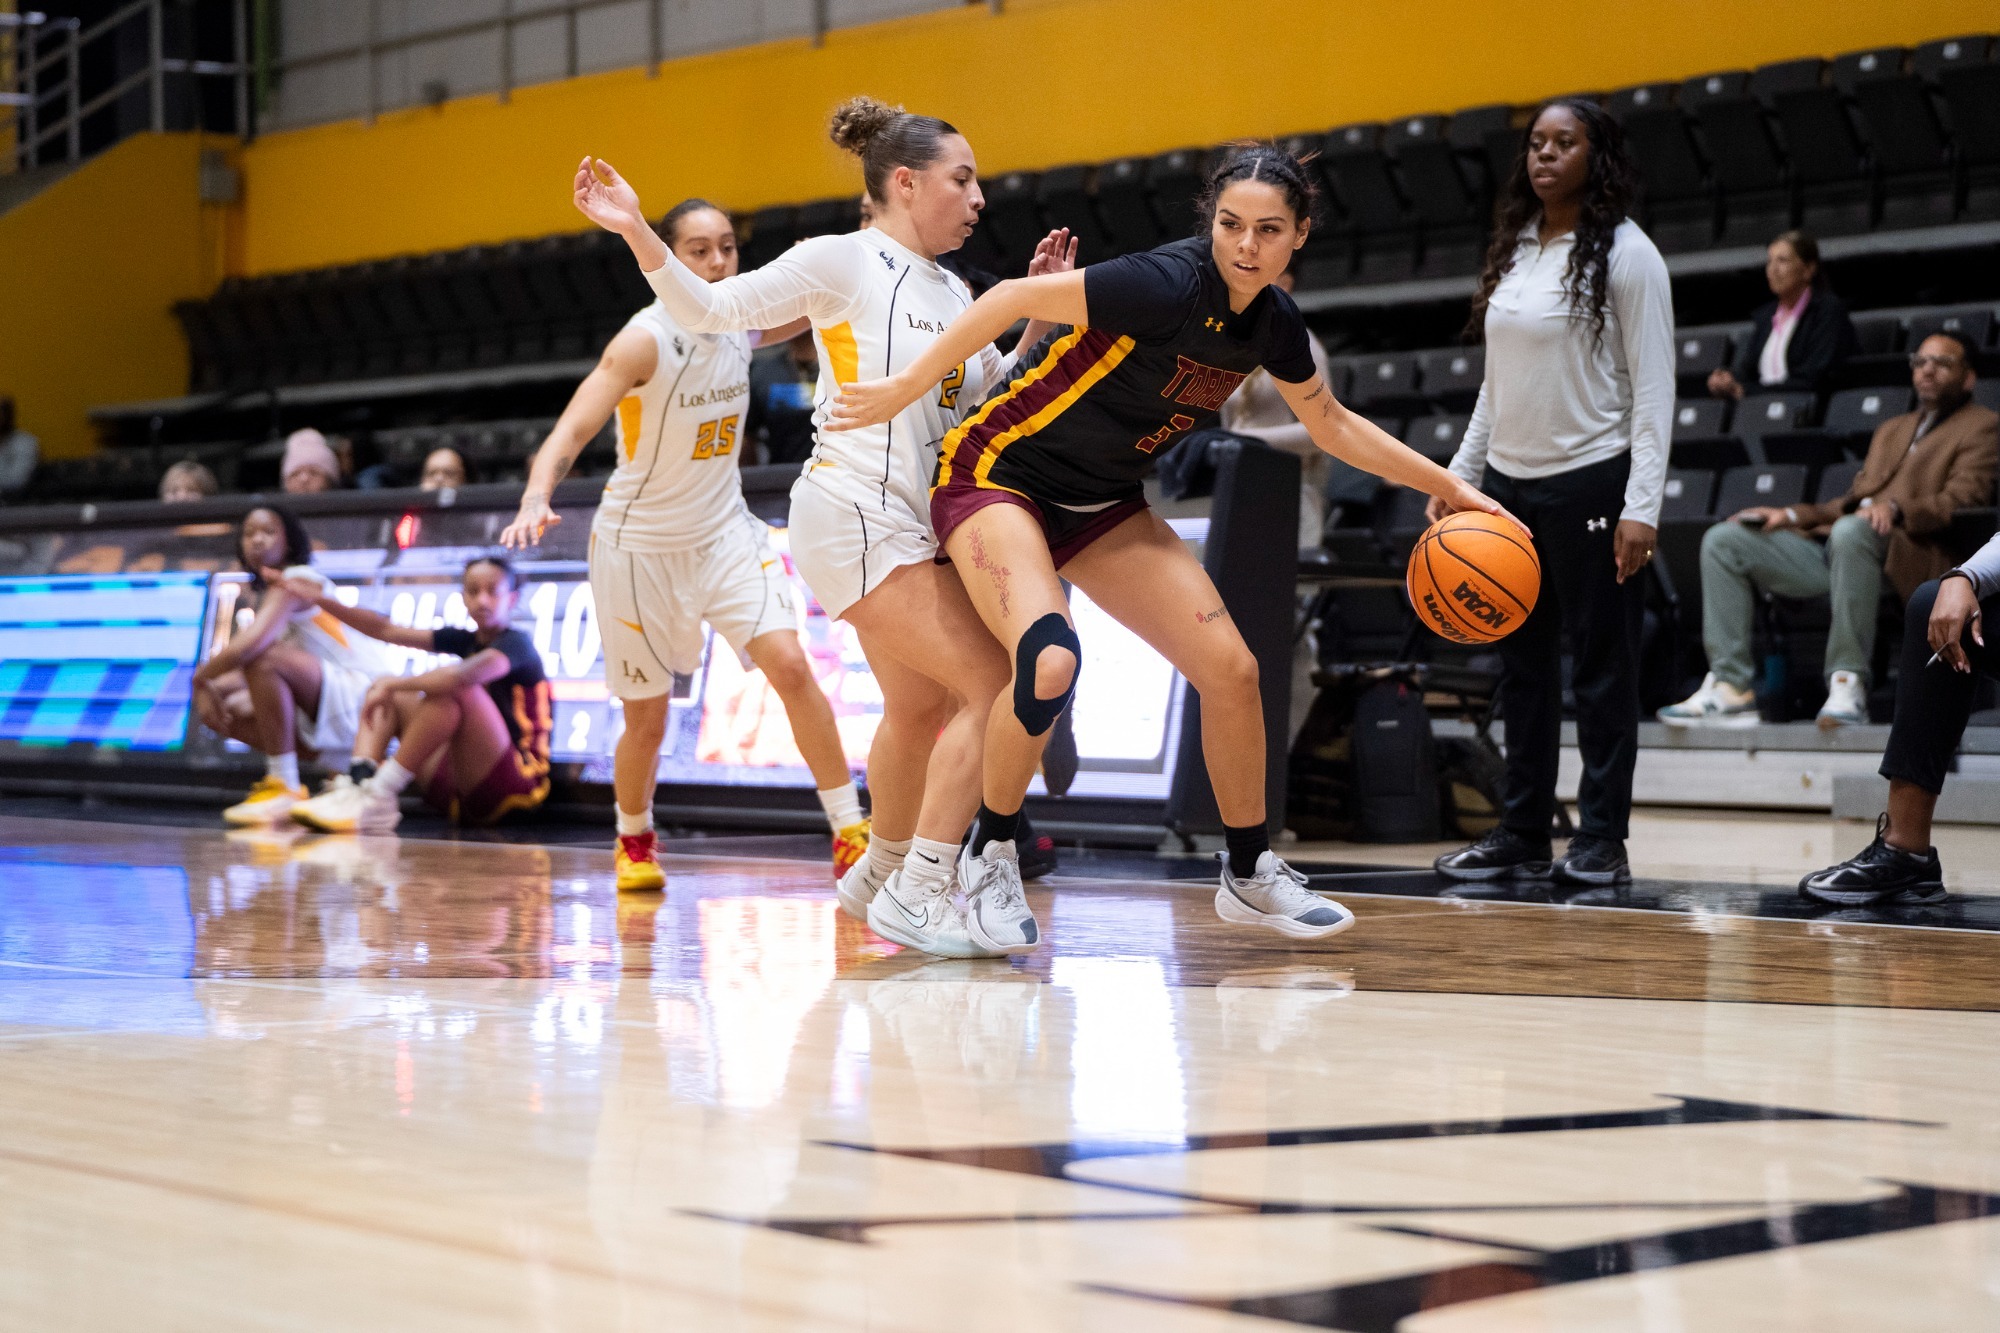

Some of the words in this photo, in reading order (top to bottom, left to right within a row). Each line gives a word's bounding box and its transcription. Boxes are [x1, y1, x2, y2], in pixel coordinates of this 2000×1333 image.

[906, 313, 934, 333] Los
[680, 392, 706, 408] Los
[708, 382, 749, 404] Angele
[691, 413, 740, 461] 25
[1452, 580, 1511, 629] NCAA
[622, 660, 649, 684] LA
[567, 710, 592, 752] 2
